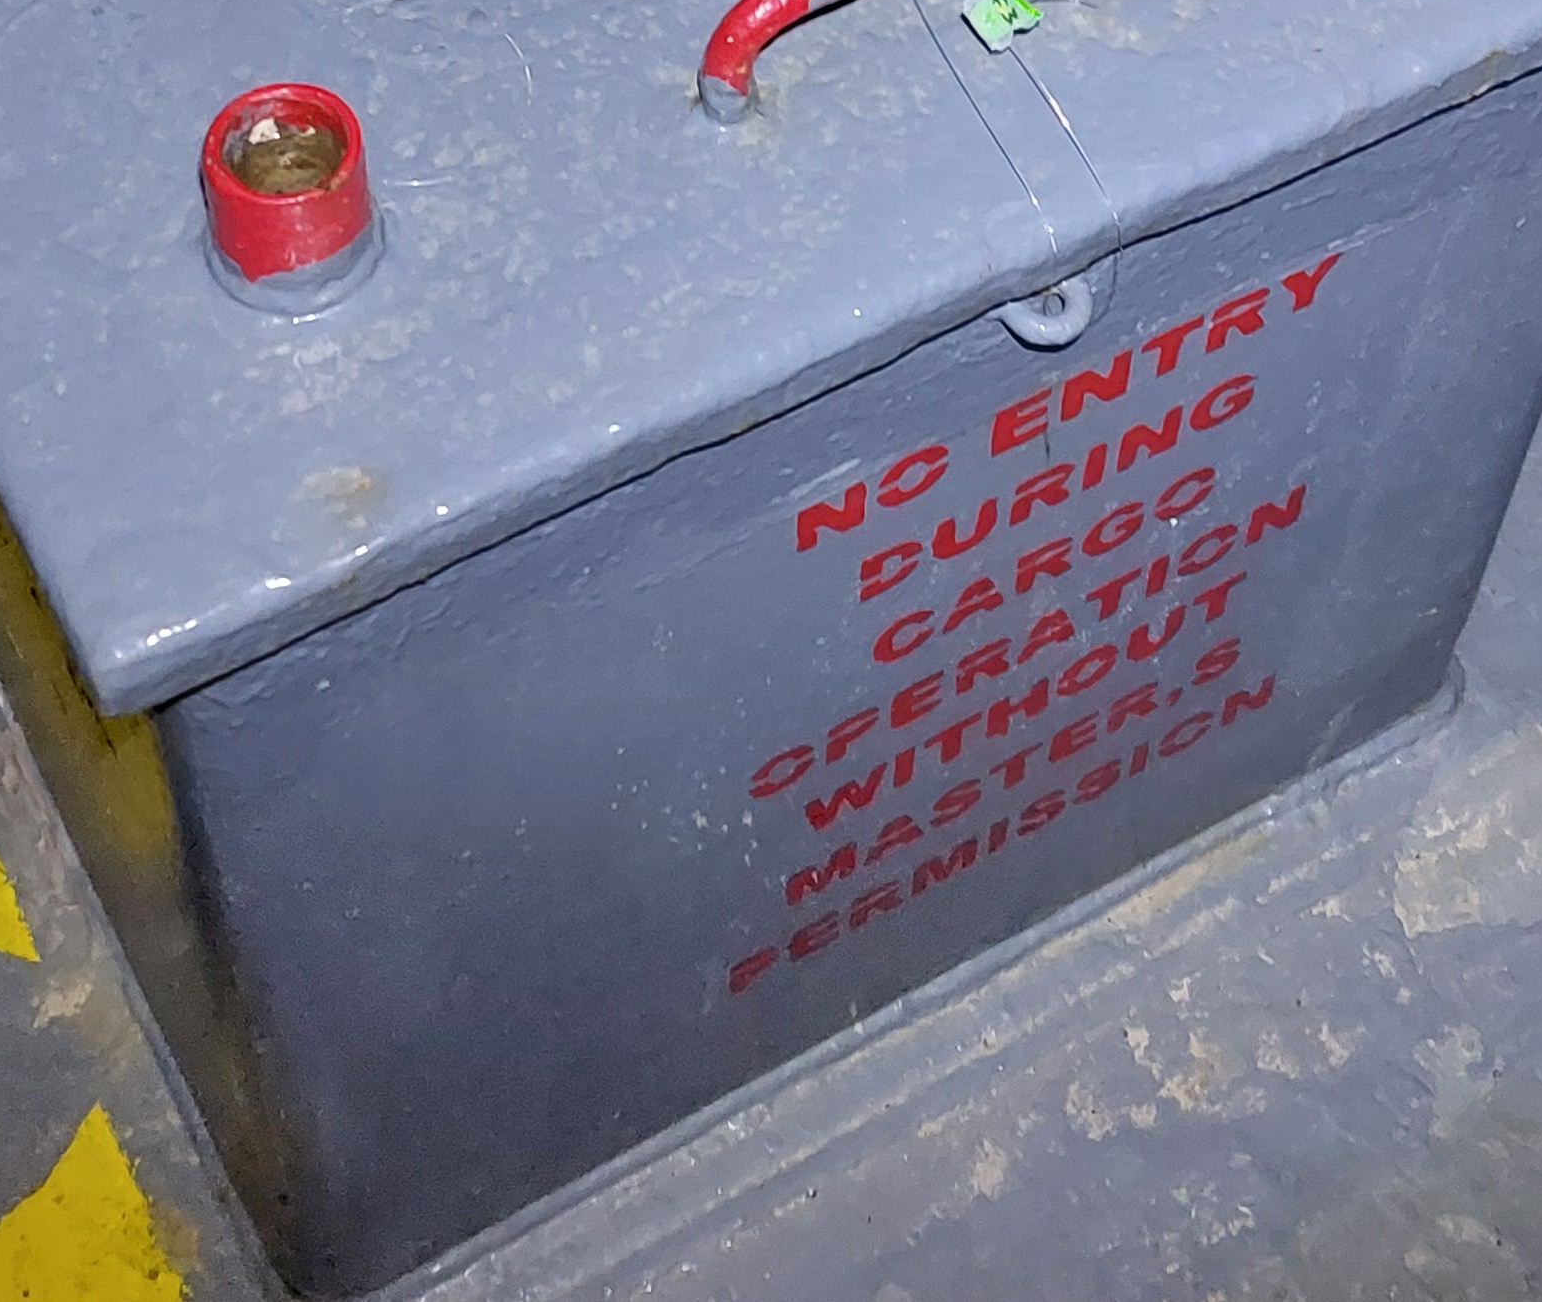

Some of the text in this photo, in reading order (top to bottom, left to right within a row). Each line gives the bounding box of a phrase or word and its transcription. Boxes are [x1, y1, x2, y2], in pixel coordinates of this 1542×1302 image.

[796, 252, 1344, 553] NO ENTRY
[859, 374, 1259, 603] DURING
[749, 484, 1307, 799] OPERATION
[803, 571, 1247, 832] WITHOUT
[872, 467, 1216, 664] CARGO
[727, 672, 1277, 995] PERMISSION
